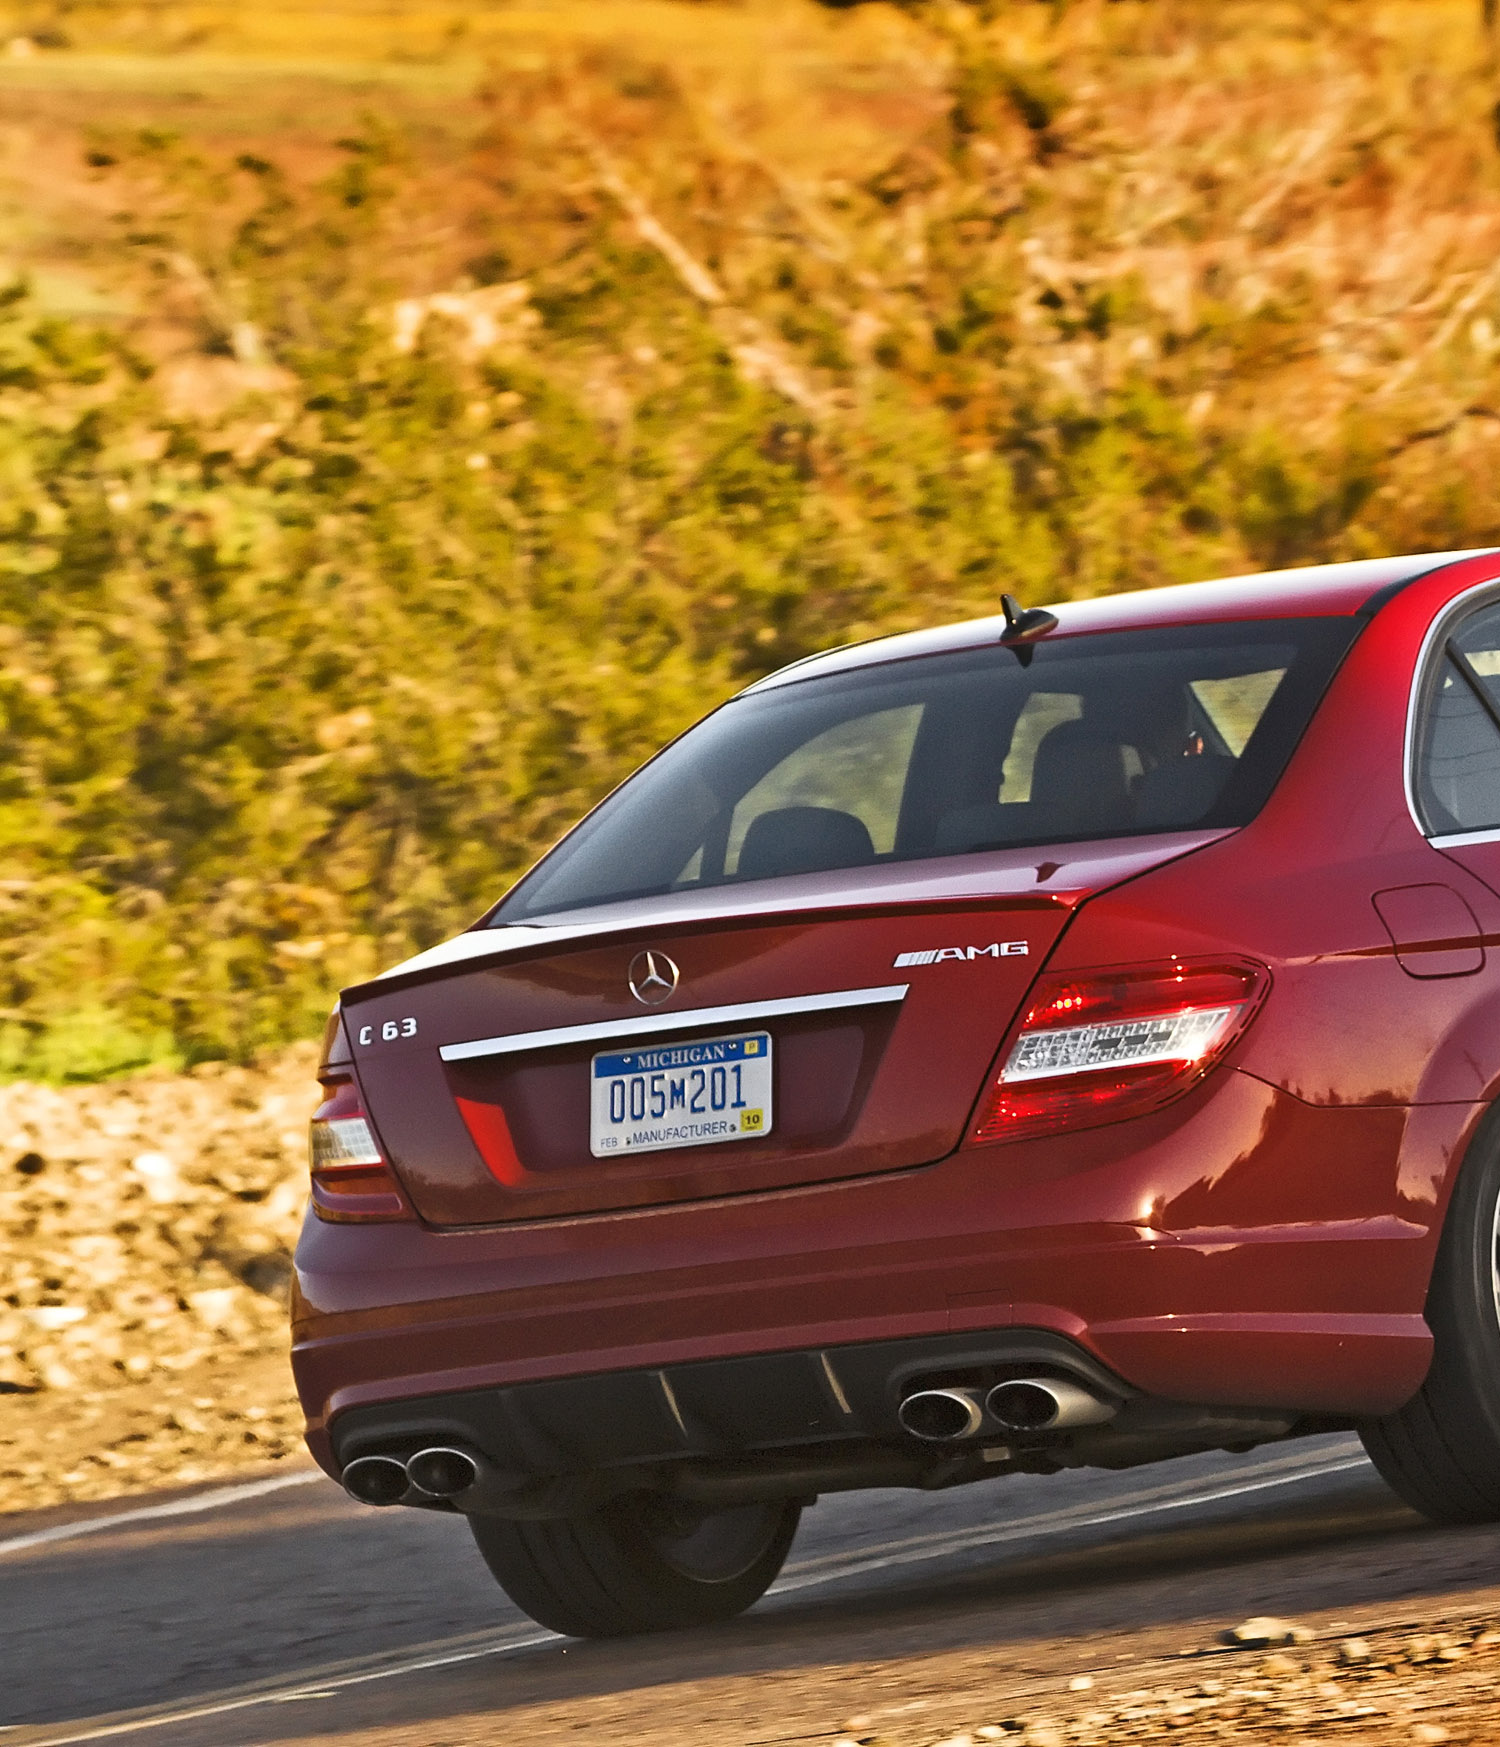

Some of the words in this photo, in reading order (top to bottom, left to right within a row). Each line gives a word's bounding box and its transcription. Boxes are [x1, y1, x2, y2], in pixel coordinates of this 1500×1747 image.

[934, 940, 1029, 963] AMG
[359, 1025, 373, 1045] C
[382, 1017, 417, 1040] 63
[637, 1044, 725, 1069] MICHIGAN
[610, 1064, 746, 1123] 005M201
[745, 1114, 760, 1125] 10
[601, 1137, 618, 1148] FEB
[632, 1120, 727, 1145] MANUFACTURER
